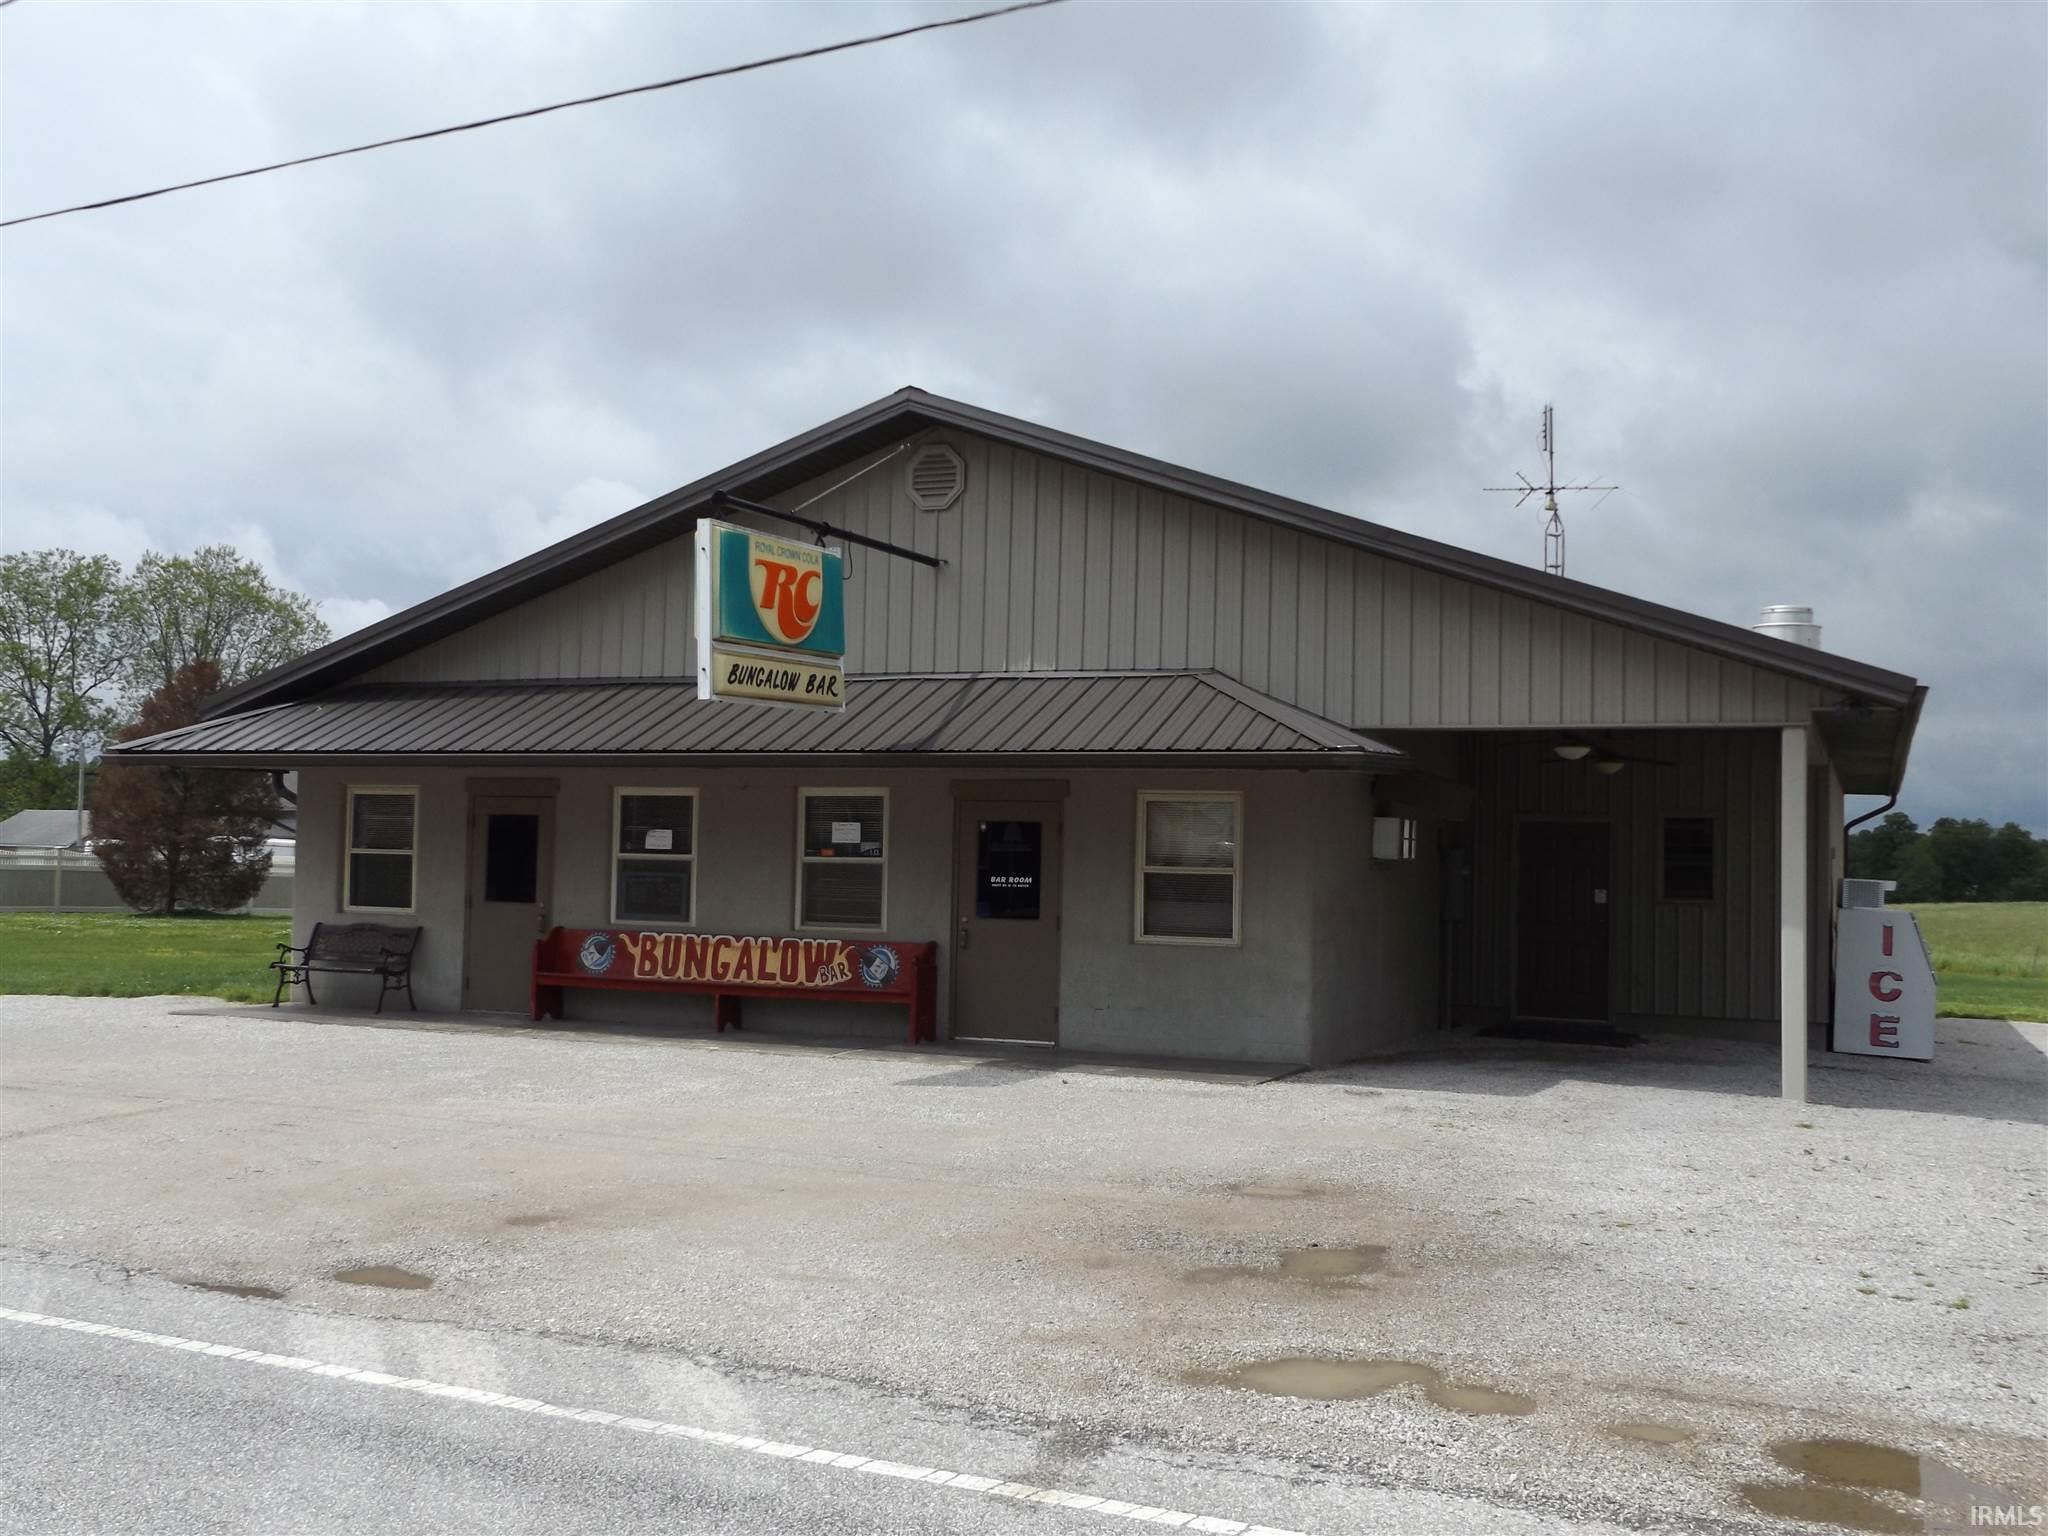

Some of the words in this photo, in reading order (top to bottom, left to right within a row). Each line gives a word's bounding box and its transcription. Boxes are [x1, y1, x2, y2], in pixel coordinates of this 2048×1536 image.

[755, 541, 776, 556] ROYAL
[777, 546, 801, 560] CROWN
[802, 551, 819, 565] COLA
[755, 558, 821, 640] RC
[727, 663, 800, 692] BUNGALOW
[805, 673, 839, 697] BAR
[1008, 876, 1032, 884] ROOM
[635, 932, 842, 986] BUNGALOW
[818, 961, 851, 985] BAR
[1869, 924, 1904, 1048] ICE
